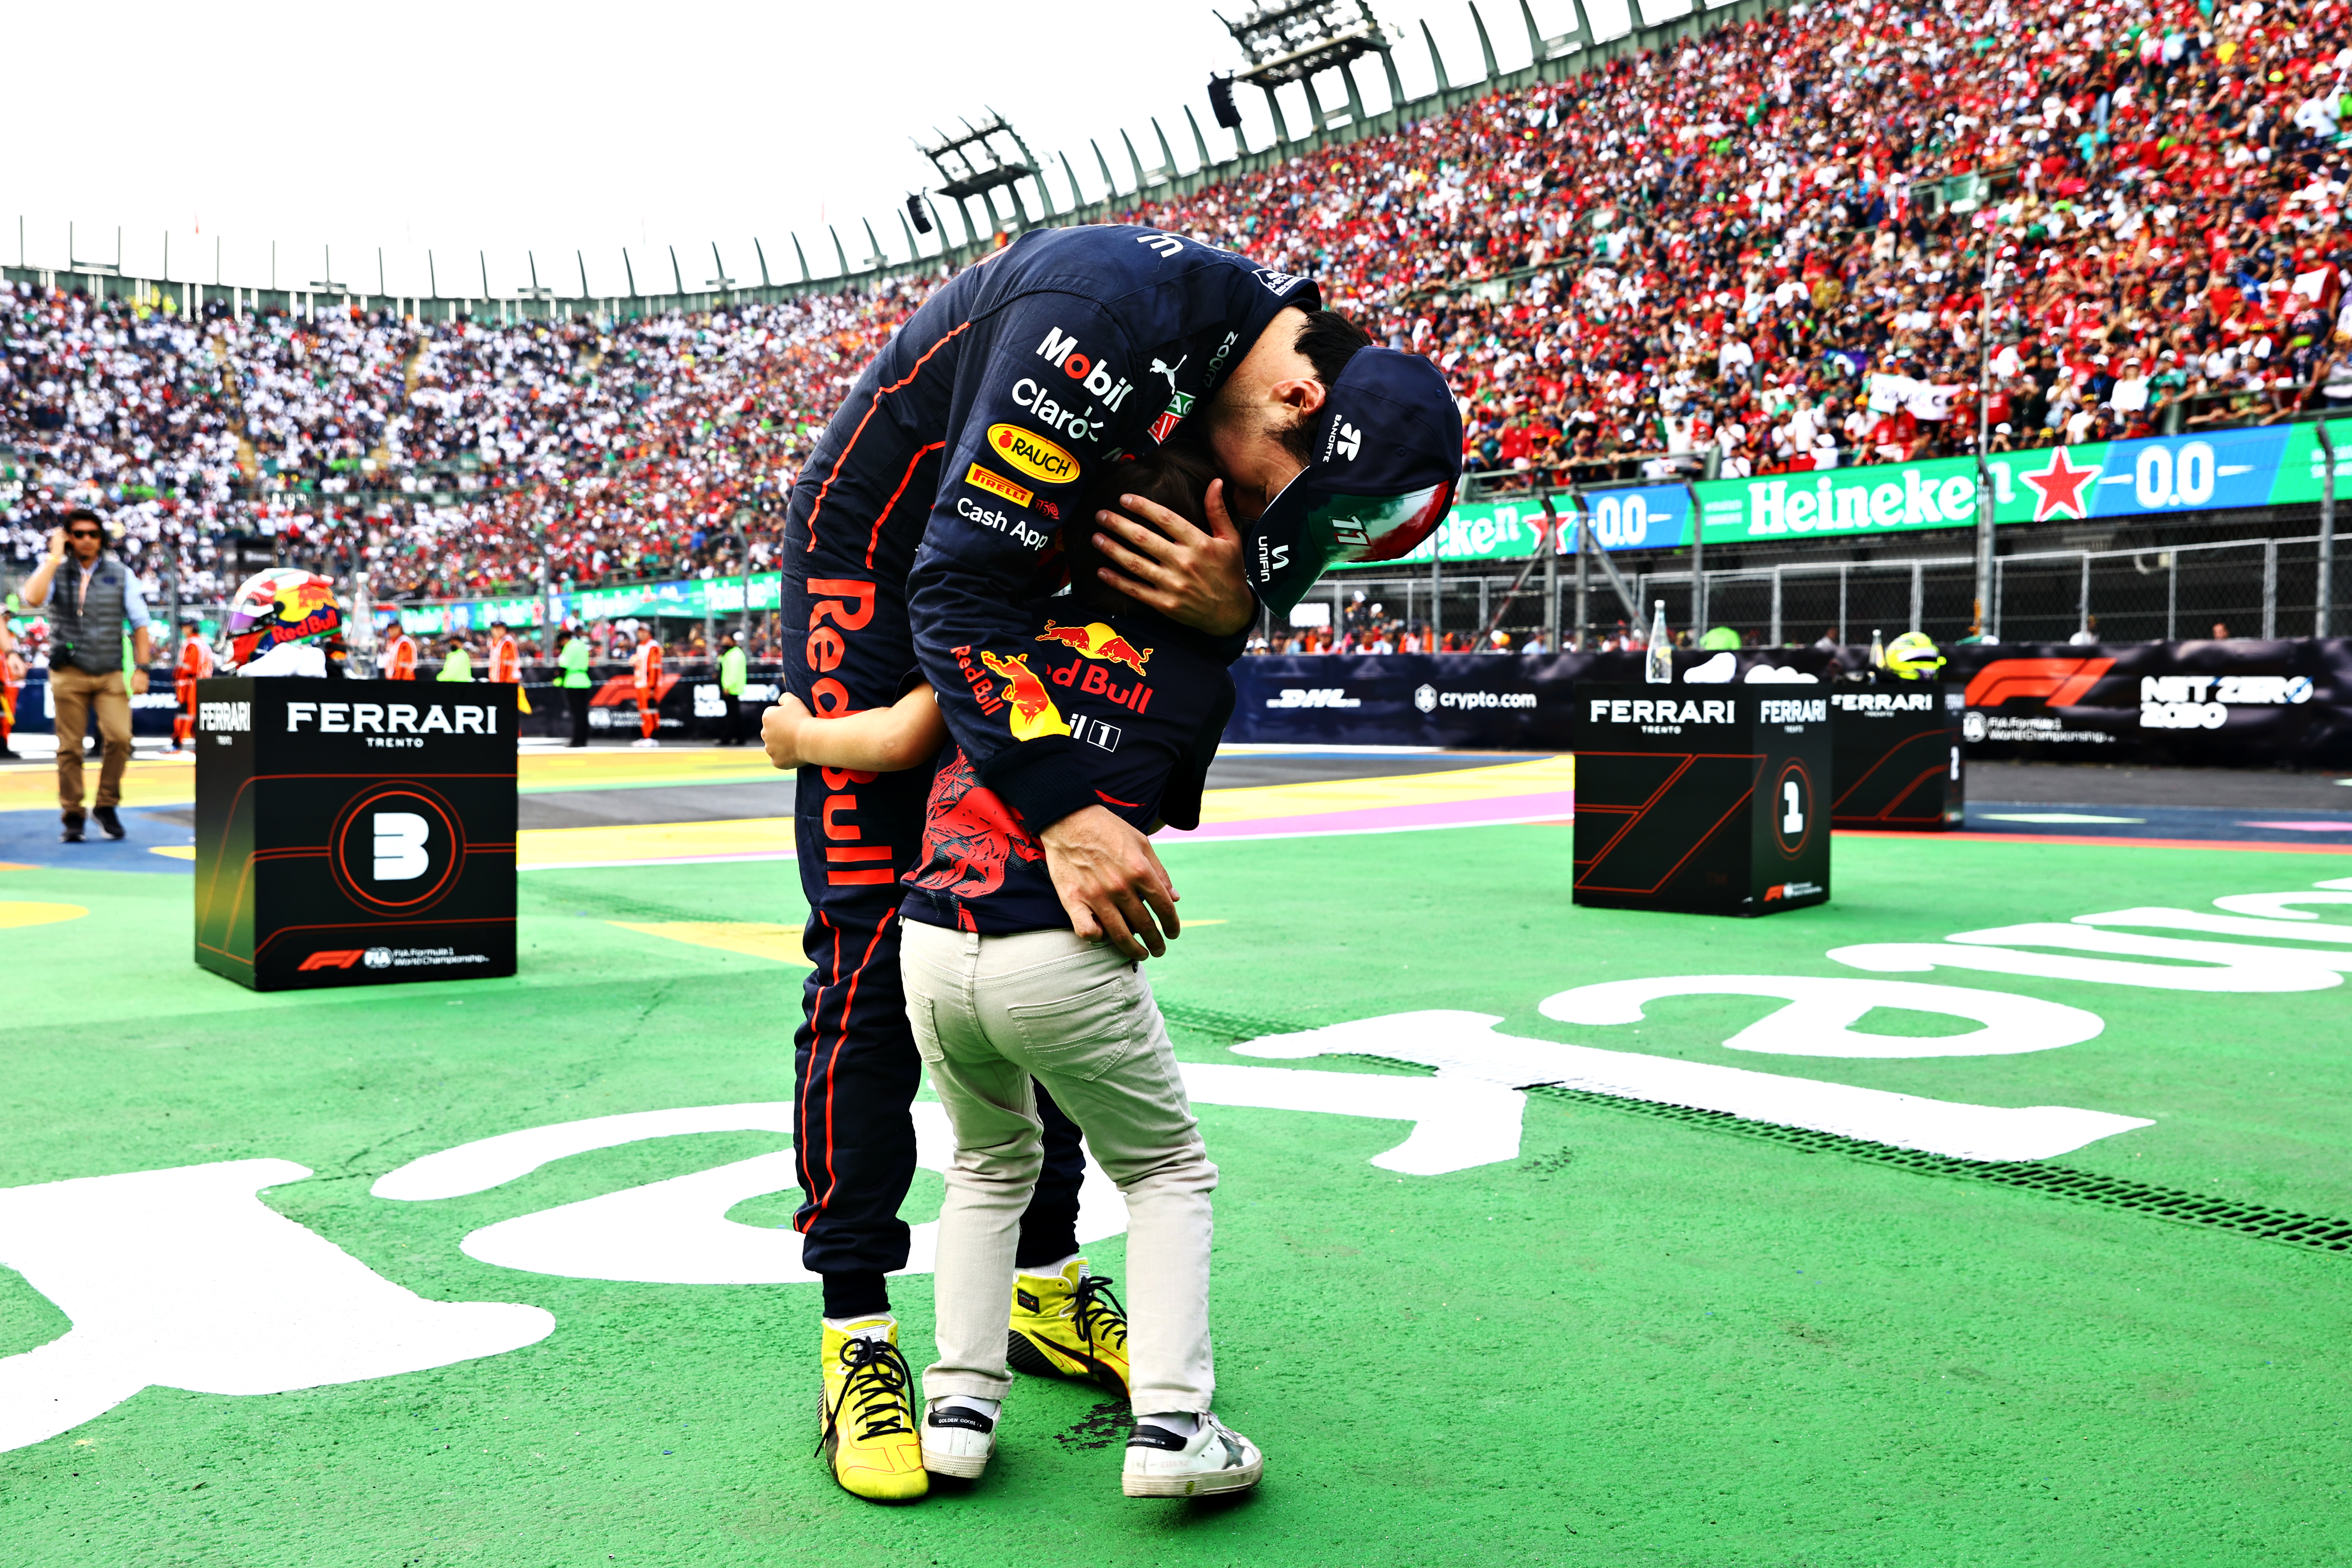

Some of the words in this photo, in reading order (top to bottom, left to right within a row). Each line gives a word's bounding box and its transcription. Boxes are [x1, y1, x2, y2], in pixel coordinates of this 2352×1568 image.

[1036, 326, 1134, 413] Mobil
[1167, 394, 1194, 415] AG
[1322, 414, 1342, 463] BANORTE
[1011, 437, 1071, 477] RAUCH
[971, 468, 1028, 502] PIRELLI
[2134, 441, 2216, 509] 0.0
[1748, 460, 2016, 536] Heineken
[957, 497, 1007, 531] Cash
[1010, 521, 1048, 550] App
[1328, 513, 1372, 546] 11
[1597, 494, 1648, 546] 0.0
[1258, 536, 1270, 582] UNIFIN
[271, 619, 309, 644] Red
[307, 609, 338, 634] Bull
[806, 578, 876, 719] Red
[950, 645, 979, 683] Red
[972, 677, 1004, 716] Bull
[1080, 664, 1153, 714] Bull
[2141, 676, 2208, 703] NET
[2215, 676, 2314, 704] ZERO
[1279, 689, 1347, 708] DHL
[1439, 690, 1537, 710] crypto.com
[1590, 700, 1736, 723] FERRARI
[1760, 699, 1826, 723] FERRARI
[199, 702, 251, 731] FERRARI
[286, 702, 497, 734] FERRARI
[1641, 725, 1681, 734] TRENTO
[366, 737, 424, 748] TRENTO
[1097, 725, 1109, 747] 1
[1783, 781, 1804, 834] 1
[373, 812, 429, 881] 3
